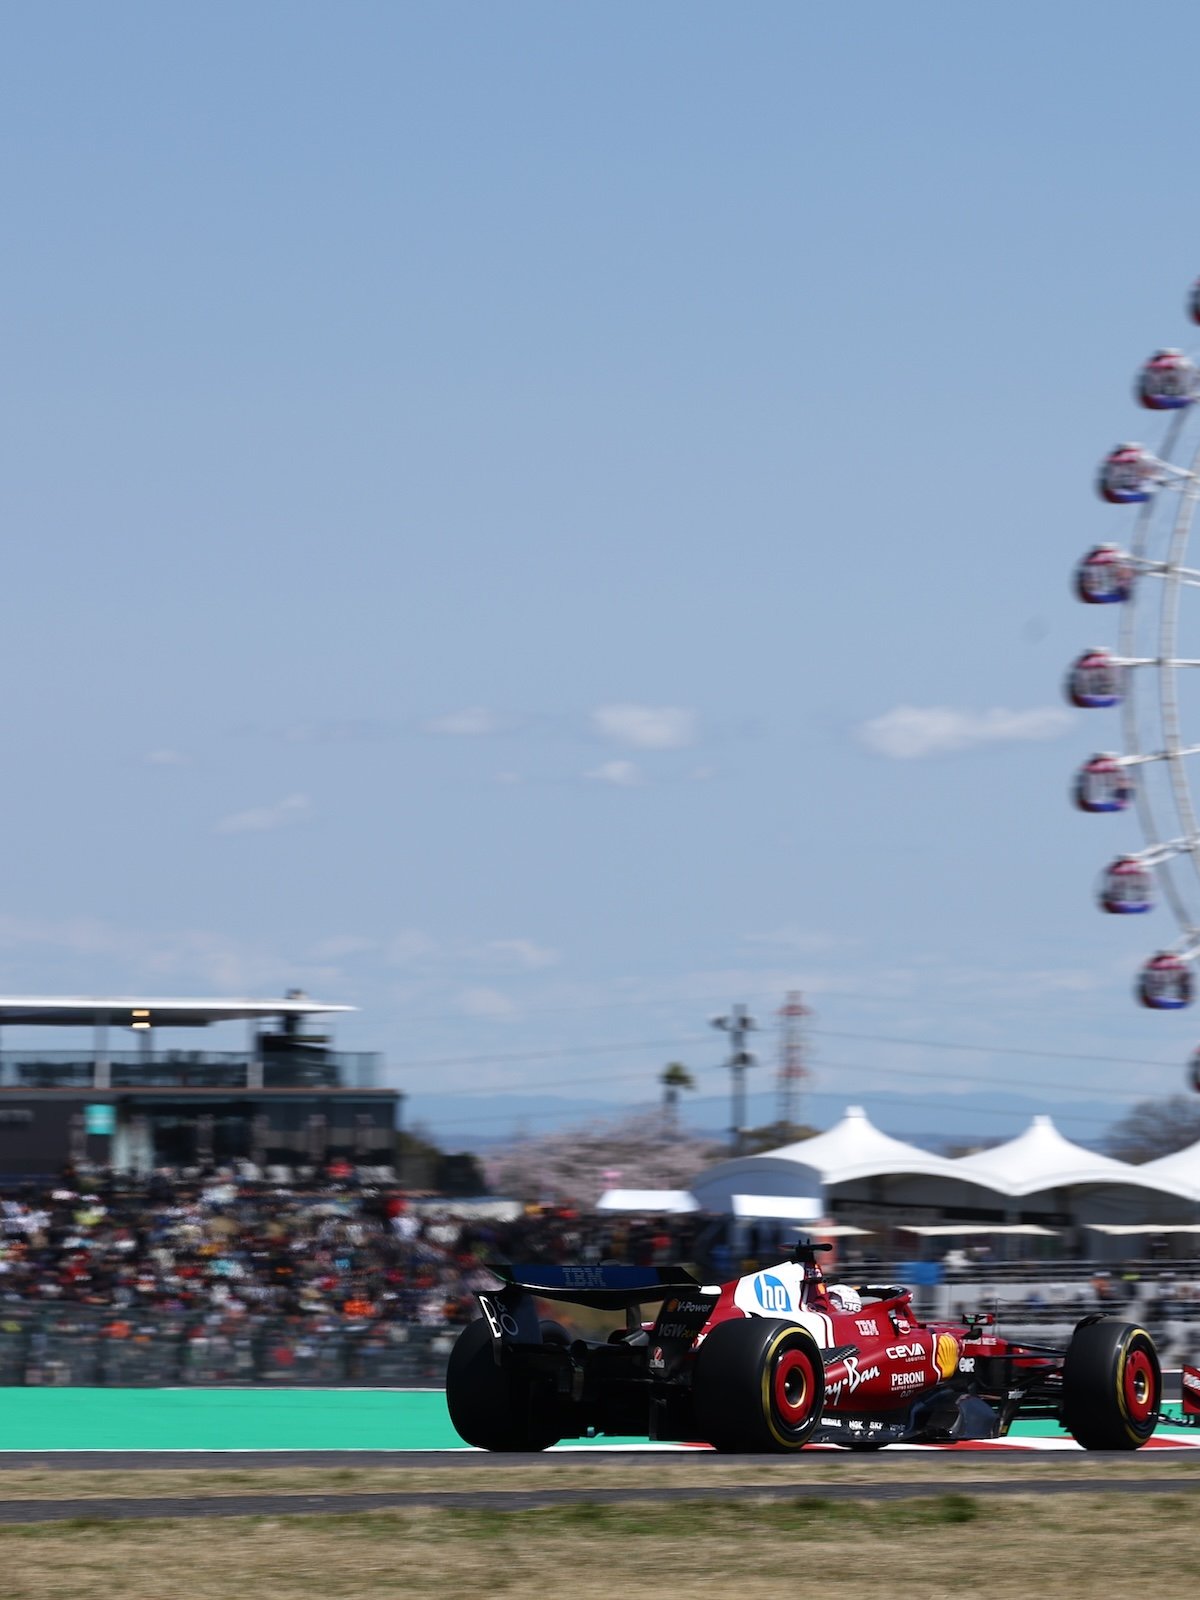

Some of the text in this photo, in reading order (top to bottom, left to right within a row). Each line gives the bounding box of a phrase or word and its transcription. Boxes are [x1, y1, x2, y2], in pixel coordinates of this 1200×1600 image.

[562, 1267, 606, 1286] IBM
[757, 1274, 790, 1311] hp
[677, 1301, 711, 1312] V-Power
[855, 1319, 879, 1336] IBM
[891, 1371, 924, 1386] PERONI
